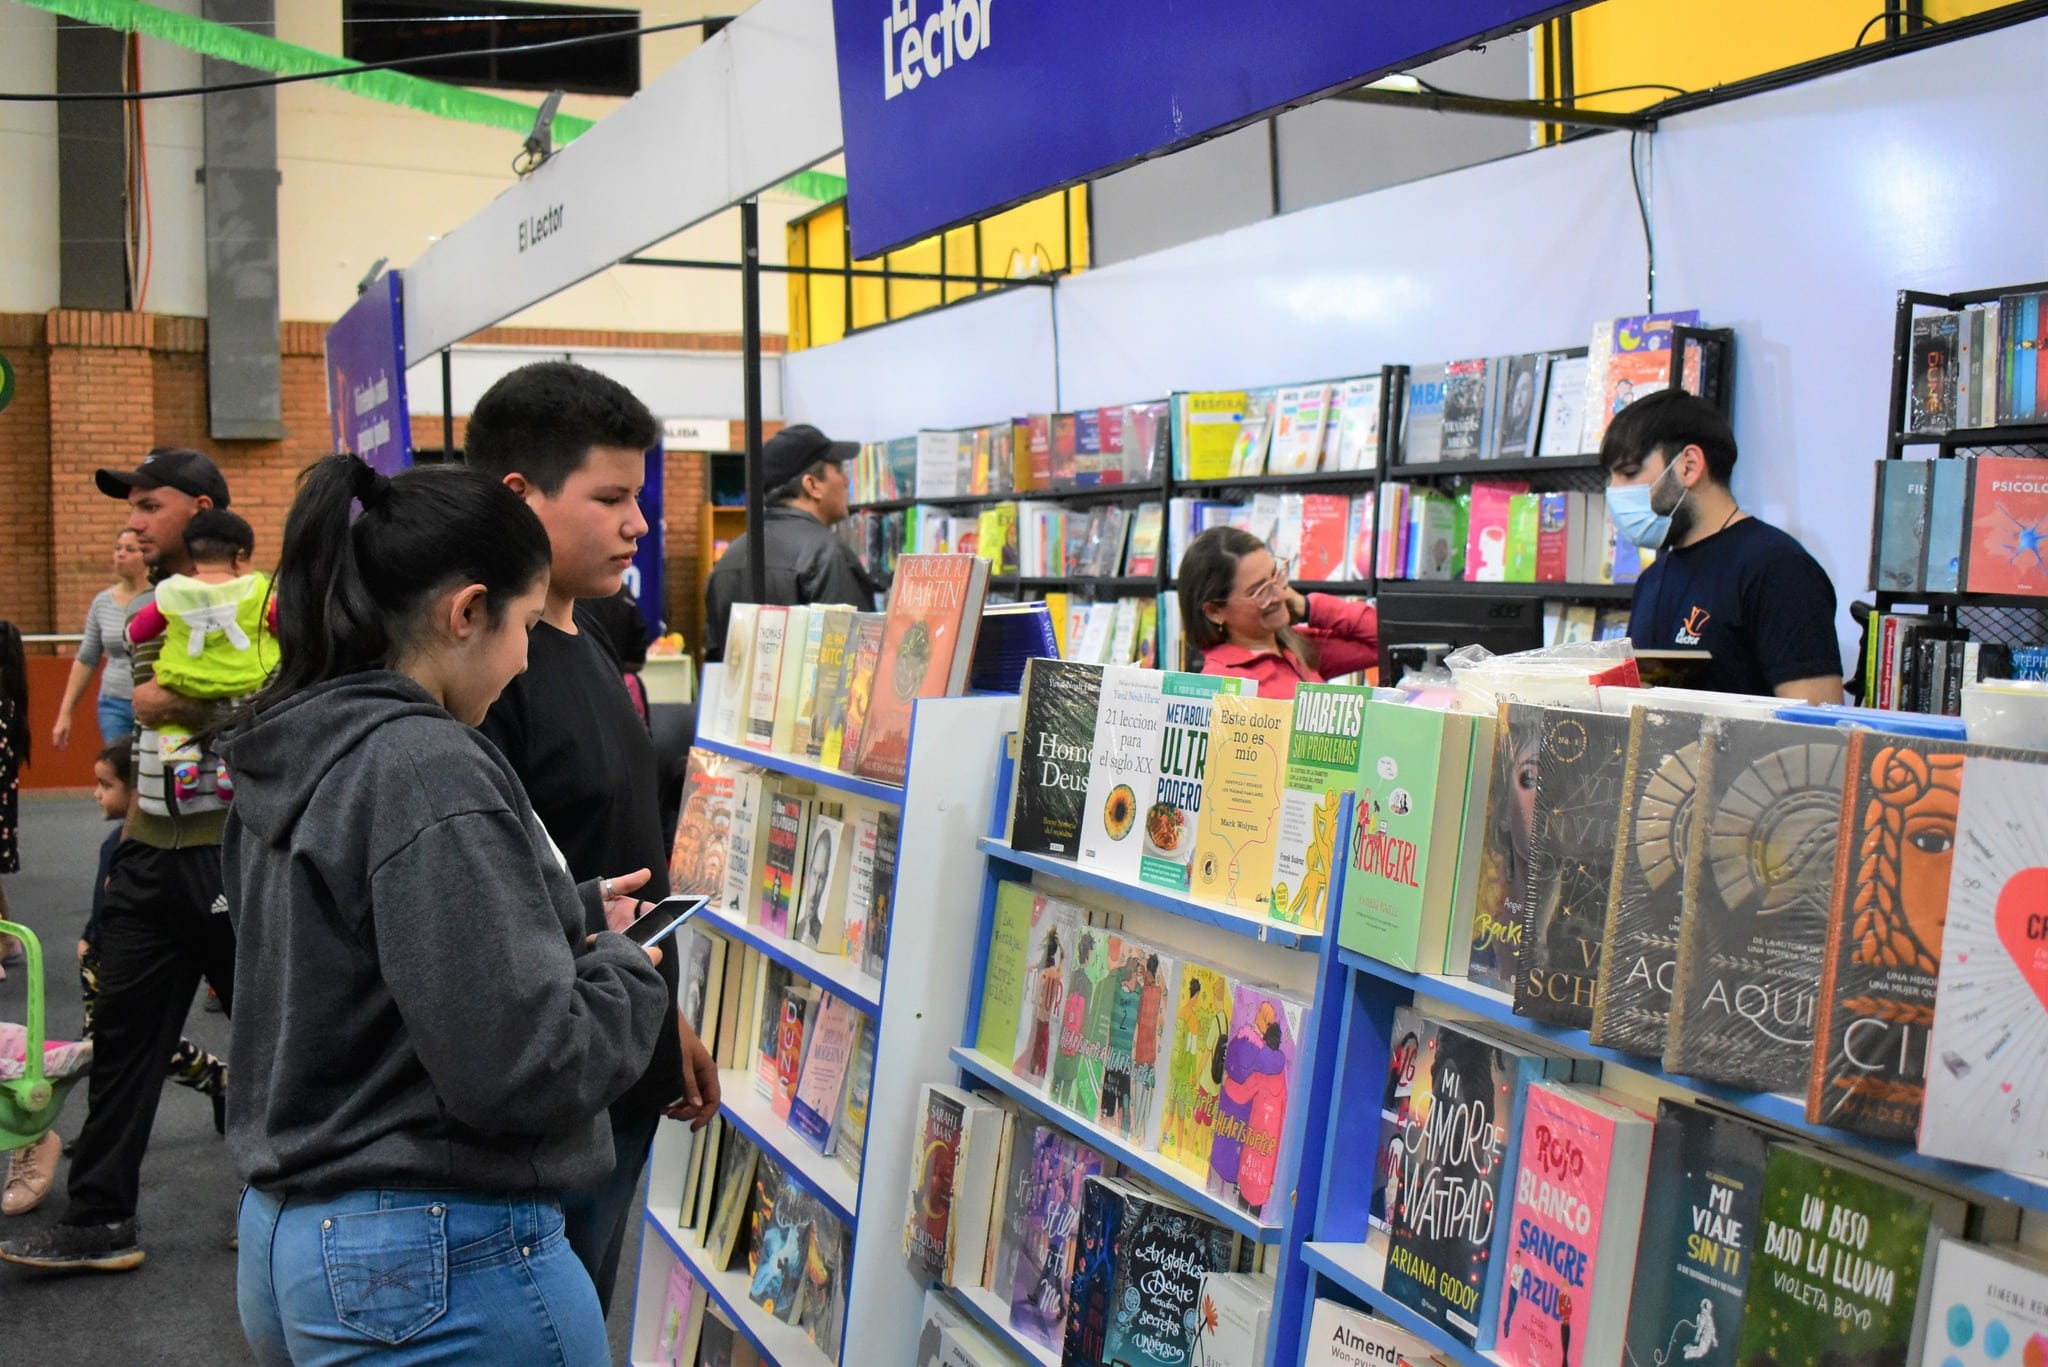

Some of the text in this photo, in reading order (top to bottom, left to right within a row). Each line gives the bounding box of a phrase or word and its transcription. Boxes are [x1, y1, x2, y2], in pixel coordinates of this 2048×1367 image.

[883, 0, 991, 100] Lector
[519, 203, 565, 252] El Lector
[663, 428, 699, 438] ALIDA
[897, 581, 961, 608] MARTIN
[1105, 708, 1117, 726] 21
[1220, 709, 1281, 730] Este dolor
[1295, 690, 1364, 738] DIABETES
[1120, 732, 1142, 750] para
[1233, 730, 1264, 746] no es
[1235, 745, 1258, 762] mío
[1292, 733, 1358, 766] SIN PROBLEMAS
[1039, 762, 1089, 792] Deus
[1099, 753, 1109, 766] el
[1110, 752, 1133, 775] siglo
[1220, 817, 1236, 828] Mark
[1747, 945, 1764, 954] UNA
[1752, 936, 1763, 945] DE
[1527, 967, 1598, 1009] SCH
[1868, 981, 1890, 991] UNA
[1891, 983, 1919, 996] MUJER
[1886, 971, 1907, 982] UNA
[1441, 1067, 1461, 1099] MI
[1214, 1109, 1277, 1157] HEARTSTOPPER
[1404, 1090, 1489, 1175] AMOR
[1481, 1122, 1505, 1155] DE
[1402, 1154, 1494, 1245] WATTPAD
[1518, 1167, 1591, 1236] BLANCO
[1708, 1183, 1733, 1215] MI
[1041, 1200, 1080, 1240] Still
[1692, 1204, 1743, 1248] VIAJE
[1800, 1192, 1870, 1251] UN BESO
[1518, 1218, 1587, 1289] SANGRE
[1687, 1233, 1741, 1276] SIN TI
[1764, 1220, 1896, 1308] BAJO LA LLUVIA
[1140, 1269, 1194, 1304] Dante
[1390, 1244, 1479, 1314] ARIANA GODOY
[1519, 1267, 1562, 1322] AZUL
[1773, 1269, 1872, 1331] VIOLETA BOYD
[1139, 1309, 1180, 1338] secretos
